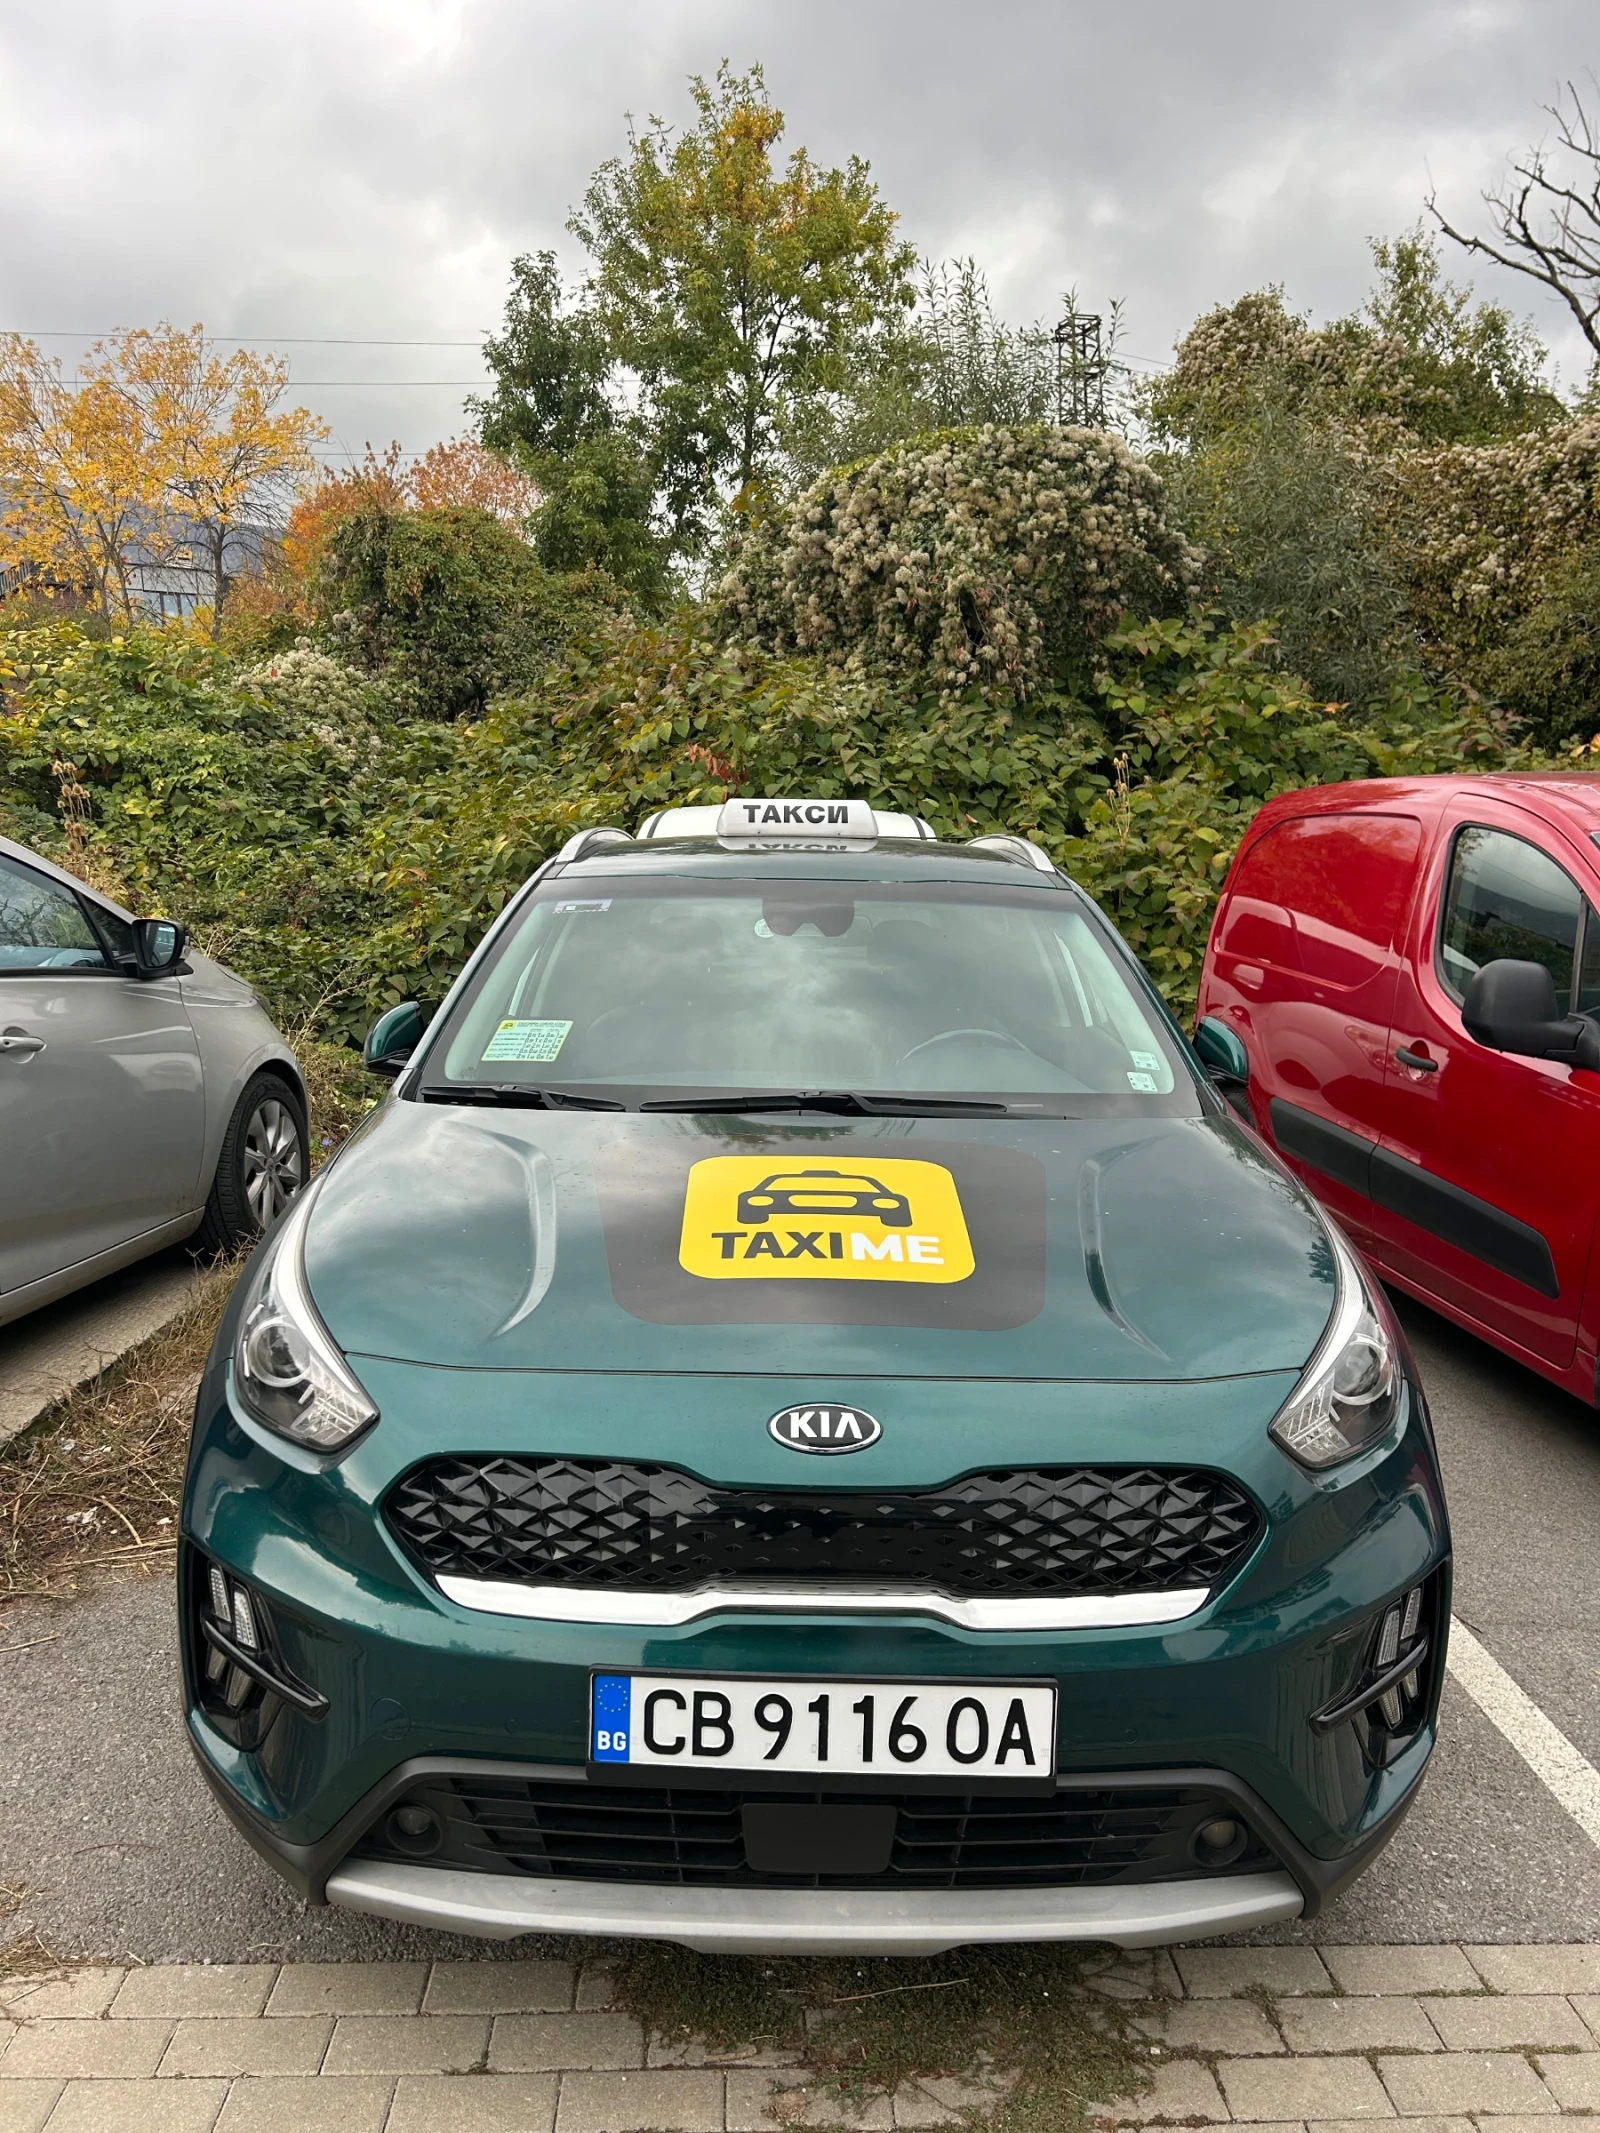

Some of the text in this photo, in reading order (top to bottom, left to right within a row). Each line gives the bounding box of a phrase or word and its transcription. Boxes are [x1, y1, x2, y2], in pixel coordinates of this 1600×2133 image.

[743, 804, 848, 824] ТАКСИ
[789, 1411, 862, 1440] KIA
[643, 1689, 734, 1756] CB
[754, 1693, 927, 1762] 9116
[597, 1730, 627, 1751] BG
